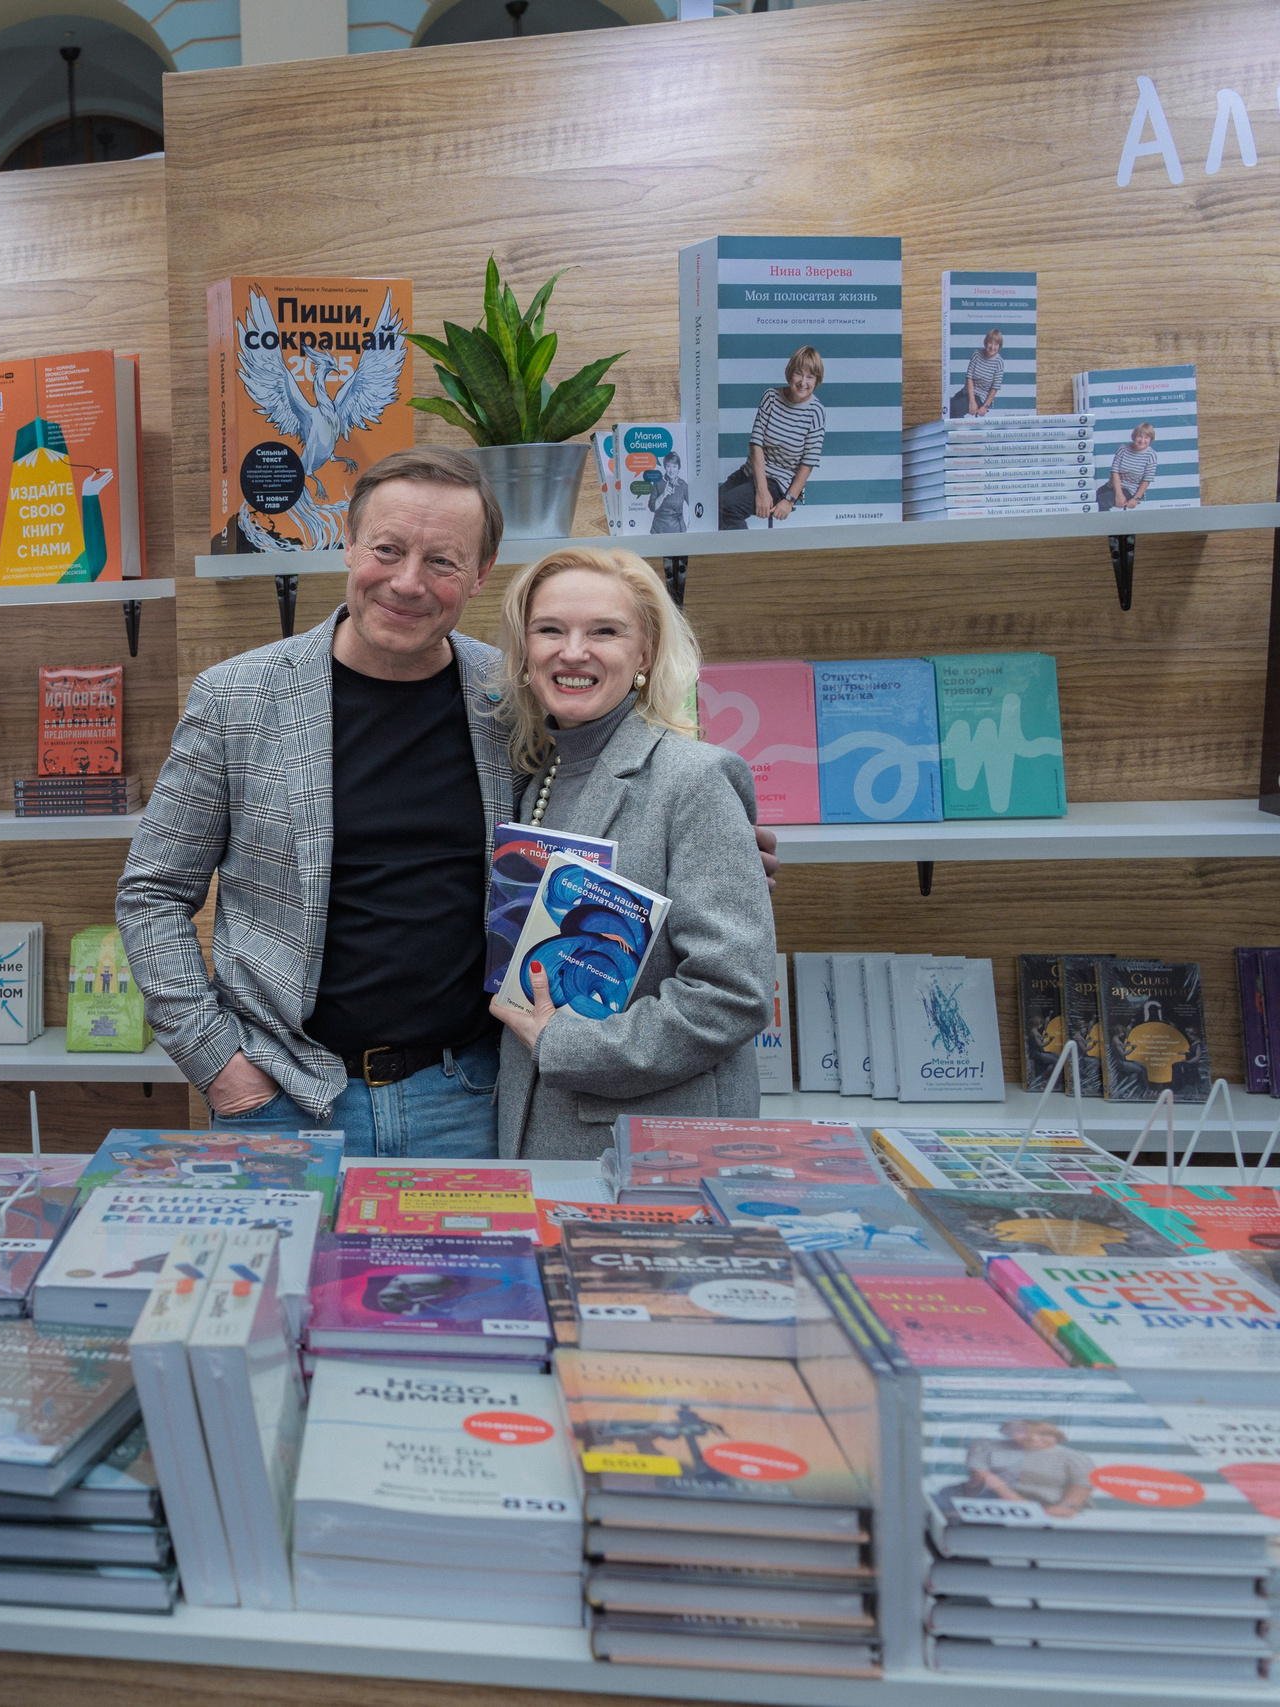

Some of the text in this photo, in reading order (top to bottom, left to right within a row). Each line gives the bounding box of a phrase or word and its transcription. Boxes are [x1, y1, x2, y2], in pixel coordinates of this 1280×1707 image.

[1117, 75, 1280, 187] Ал
[770, 265, 853, 280] Нина Зверева
[744, 290, 878, 302] Моя полосатая жизнь
[277, 297, 370, 328] Пиши,
[756, 317, 866, 325] Рассказы оголтелой оптимистки
[244, 325, 396, 356] сокращай
[220, 402, 228, 474] сокращай
[634, 432, 662, 440] Магия
[630, 441, 667, 449] общения
[10, 480, 74, 500] ИЗДАЙТЕ
[19, 503, 65, 520] СВОЮ
[22, 522, 65, 539] КНИГУ
[17, 542, 71, 558] С НАМИ
[821, 672, 873, 685] Отпусти
[943, 666, 1003, 679] Не корми
[822, 681, 901, 694] внутреннего
[943, 677, 976, 686] свою
[45, 691, 116, 707] ИСПОВЕДЬ
[822, 691, 874, 703] критика
[943, 686, 993, 698] тревогу
[45, 718, 116, 728] САМОЗВАНЦА
[44, 729, 116, 739] ПРЕДПРИНИМАТЕЛЯ
[561, 878, 646, 924] бессознательного
[582, 877, 649, 916] Тайны нашего
[557, 950, 621, 985] Андрей Россохин
[1130, 972, 1170, 986] Сила
[506, 997, 525, 1010] Теория
[921, 1061, 984, 1078] бесит!
[642, 1119, 734, 1127] Больше,
[693, 1125, 791, 1133] коробка
[111, 1194, 300, 1207] ЦЕННОСТЬ
[106, 1204, 250, 1215] ВАШИХ
[586, 1207, 684, 1218] Пиши,
[100, 1215, 294, 1227] РЕШЕНИЙ
[371, 1237, 514, 1246] ИСКУССТВЕННЫЙ
[369, 1259, 502, 1269] ЧЕЛОВЕЧЕСТВА
[590, 1253, 788, 1271] ChatGPT
[645, 1266, 717, 1274] каждый
[1042, 1267, 1240, 1287] ПОНЯТЬ
[1063, 1285, 1278, 1315] СЕБЯ
[1091, 1312, 1122, 1326] И
[386, 1377, 490, 1396] Надо
[385, 1440, 493, 1458] МНЕ БЫ
[398, 1452, 484, 1468] УМЕТЬ
[414, 1464, 498, 1480] ЗНАТЬ
[500, 1496, 568, 1513] 850
